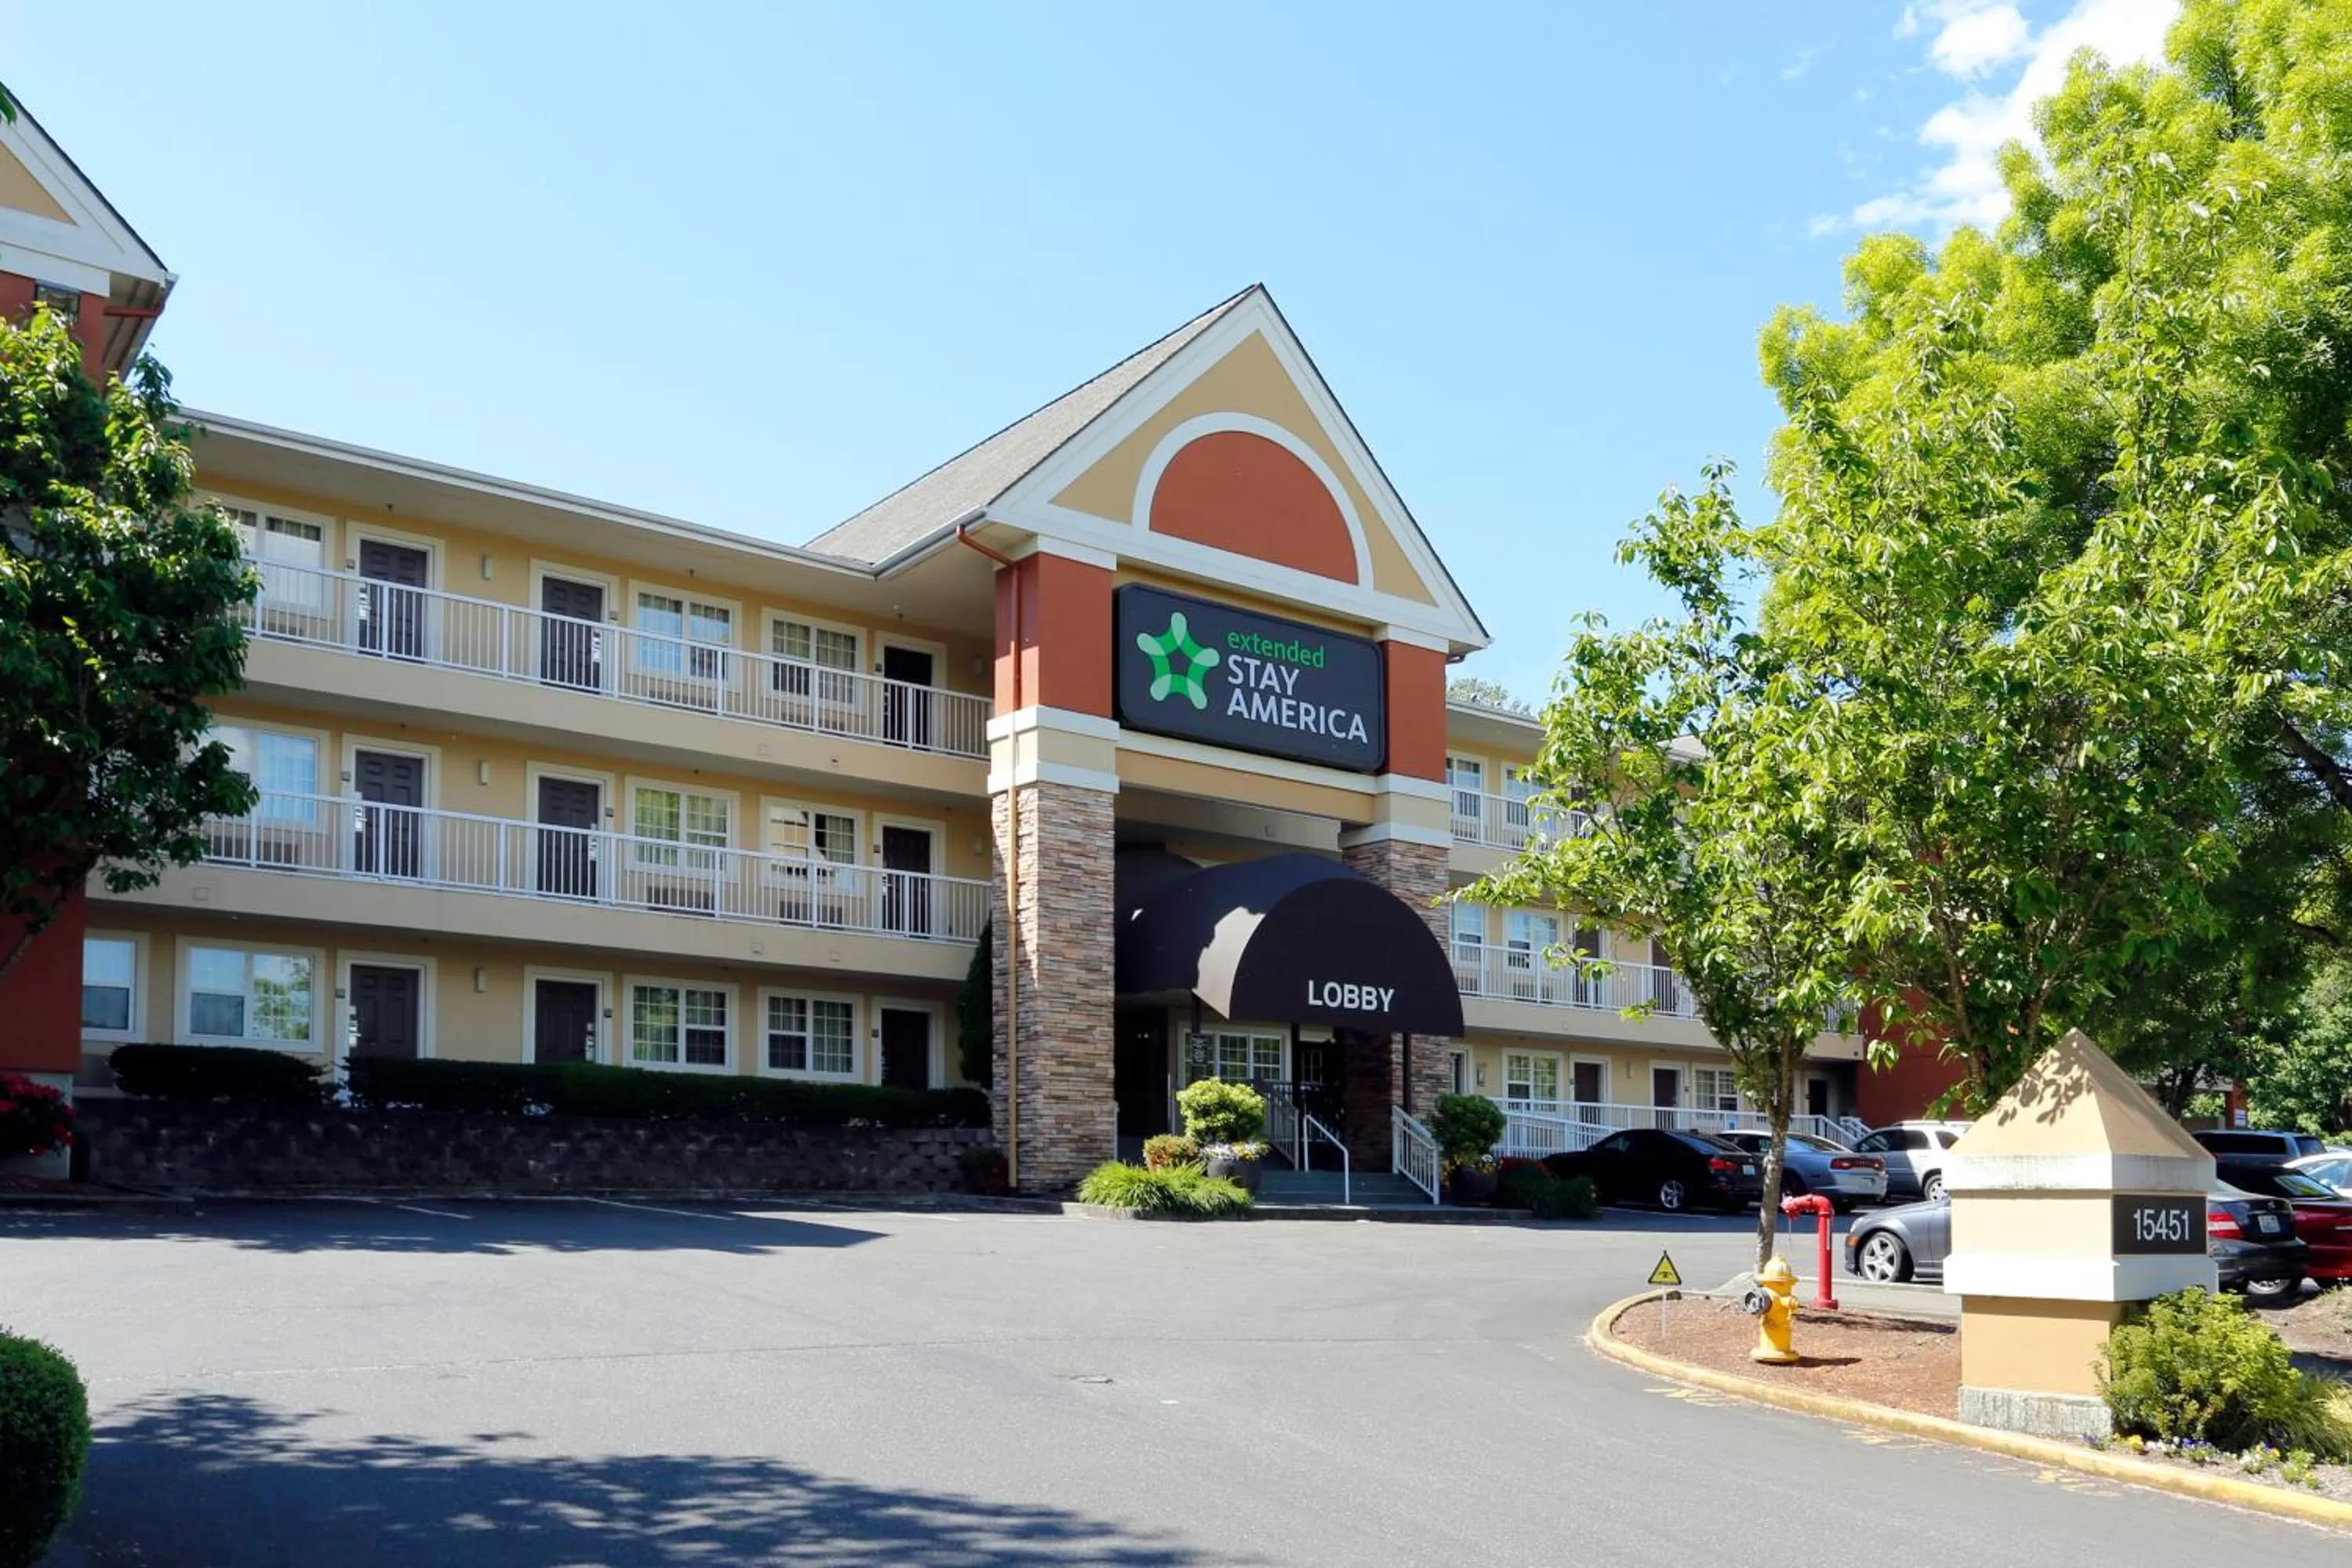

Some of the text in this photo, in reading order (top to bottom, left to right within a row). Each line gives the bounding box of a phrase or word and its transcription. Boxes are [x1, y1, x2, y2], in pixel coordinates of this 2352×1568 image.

[1227, 631, 1324, 667] extended
[1228, 654, 1299, 695] STAY
[1227, 688, 1368, 743] AMERICA
[1308, 979, 1395, 1012] LOBBY
[2132, 1208, 2190, 1241] 15451
